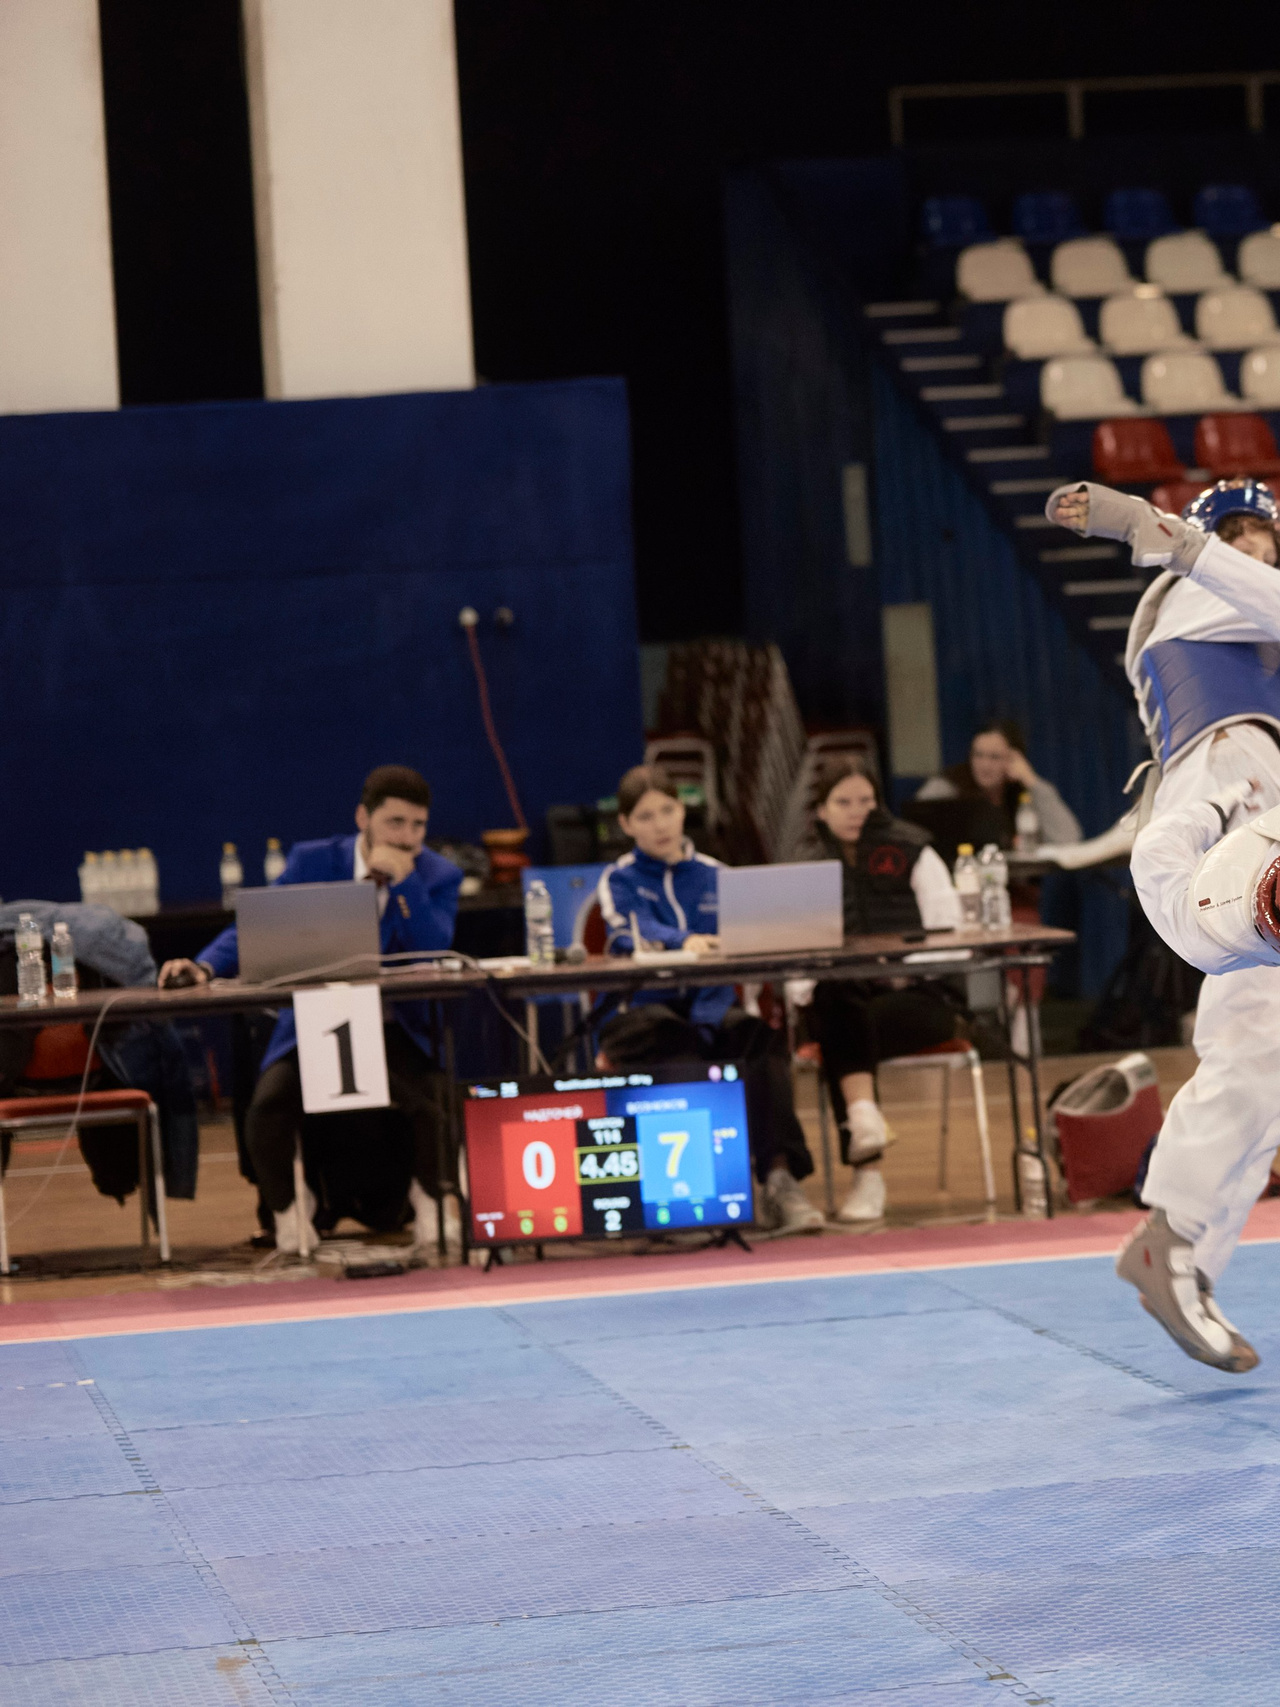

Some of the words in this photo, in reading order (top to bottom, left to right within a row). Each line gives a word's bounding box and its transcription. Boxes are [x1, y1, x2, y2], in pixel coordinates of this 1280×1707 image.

[322, 1020, 369, 1098] 1
[522, 1141, 556, 1190] 0
[580, 1150, 639, 1179] 4.45
[658, 1132, 690, 1178] 7
[484, 1221, 495, 1238] 1
[604, 1210, 622, 1232] 2
